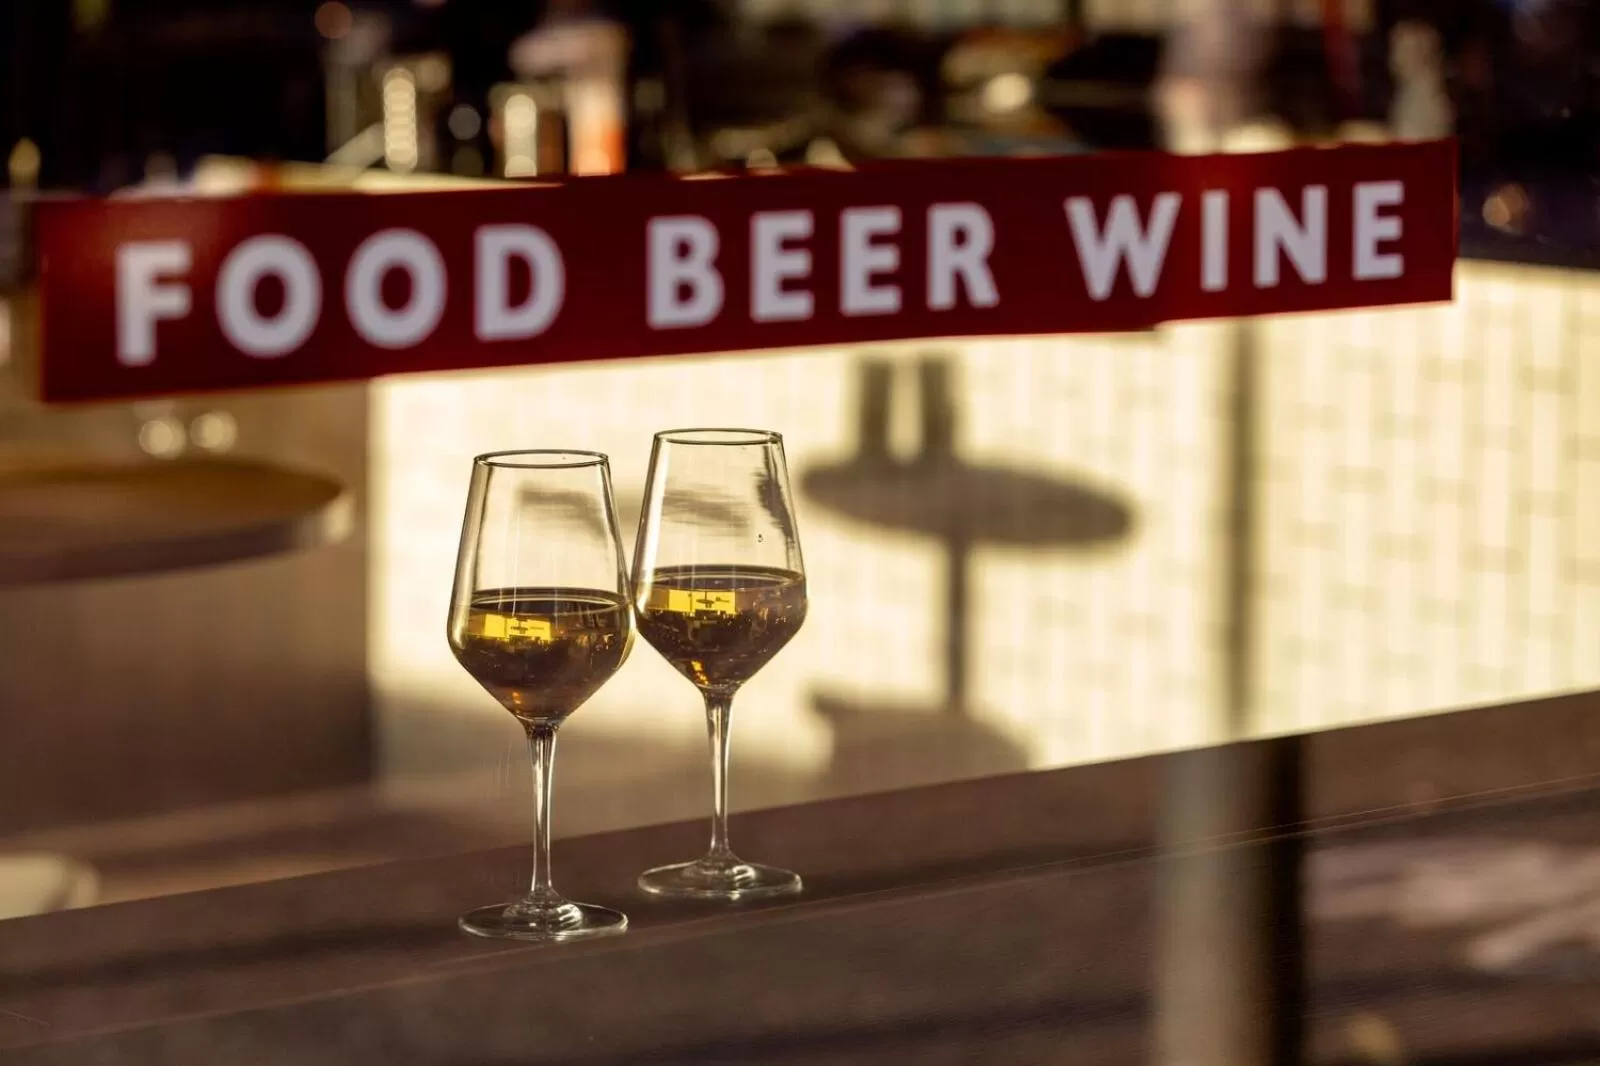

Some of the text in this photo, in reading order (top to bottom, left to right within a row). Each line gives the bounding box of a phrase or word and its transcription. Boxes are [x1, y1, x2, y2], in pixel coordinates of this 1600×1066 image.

[115, 180, 1406, 365] FOOD BEER WINE
